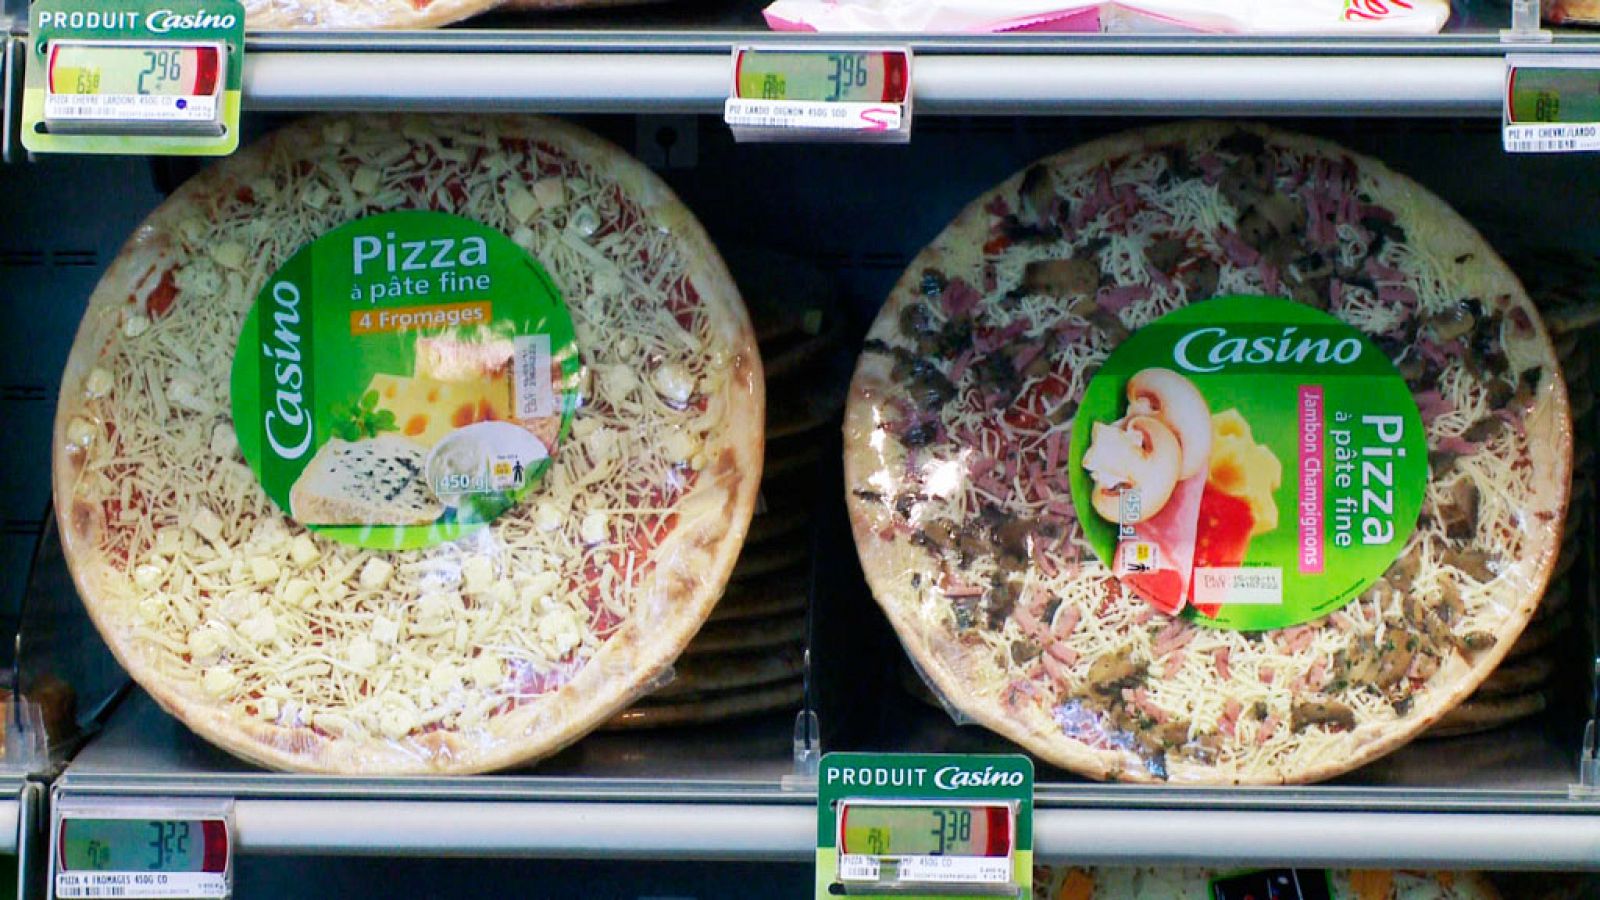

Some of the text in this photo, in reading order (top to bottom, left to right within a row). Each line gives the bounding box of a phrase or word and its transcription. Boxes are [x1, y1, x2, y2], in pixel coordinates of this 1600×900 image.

[38, 10, 236, 33] PRODUIT Casino
[352, 231, 488, 276] Pizza
[351, 271, 490, 303] à pâte fine
[359, 305, 484, 329] 4 Fromages
[263, 281, 313, 460] Casino
[1173, 326, 1363, 373] Casino
[441, 473, 470, 489] 450
[1300, 392, 1322, 566] Jambon Champignons
[1329, 410, 1358, 548] à pâte fine
[1361, 414, 1407, 545] Pizza
[827, 766, 1024, 790] PRODUIT Casino
